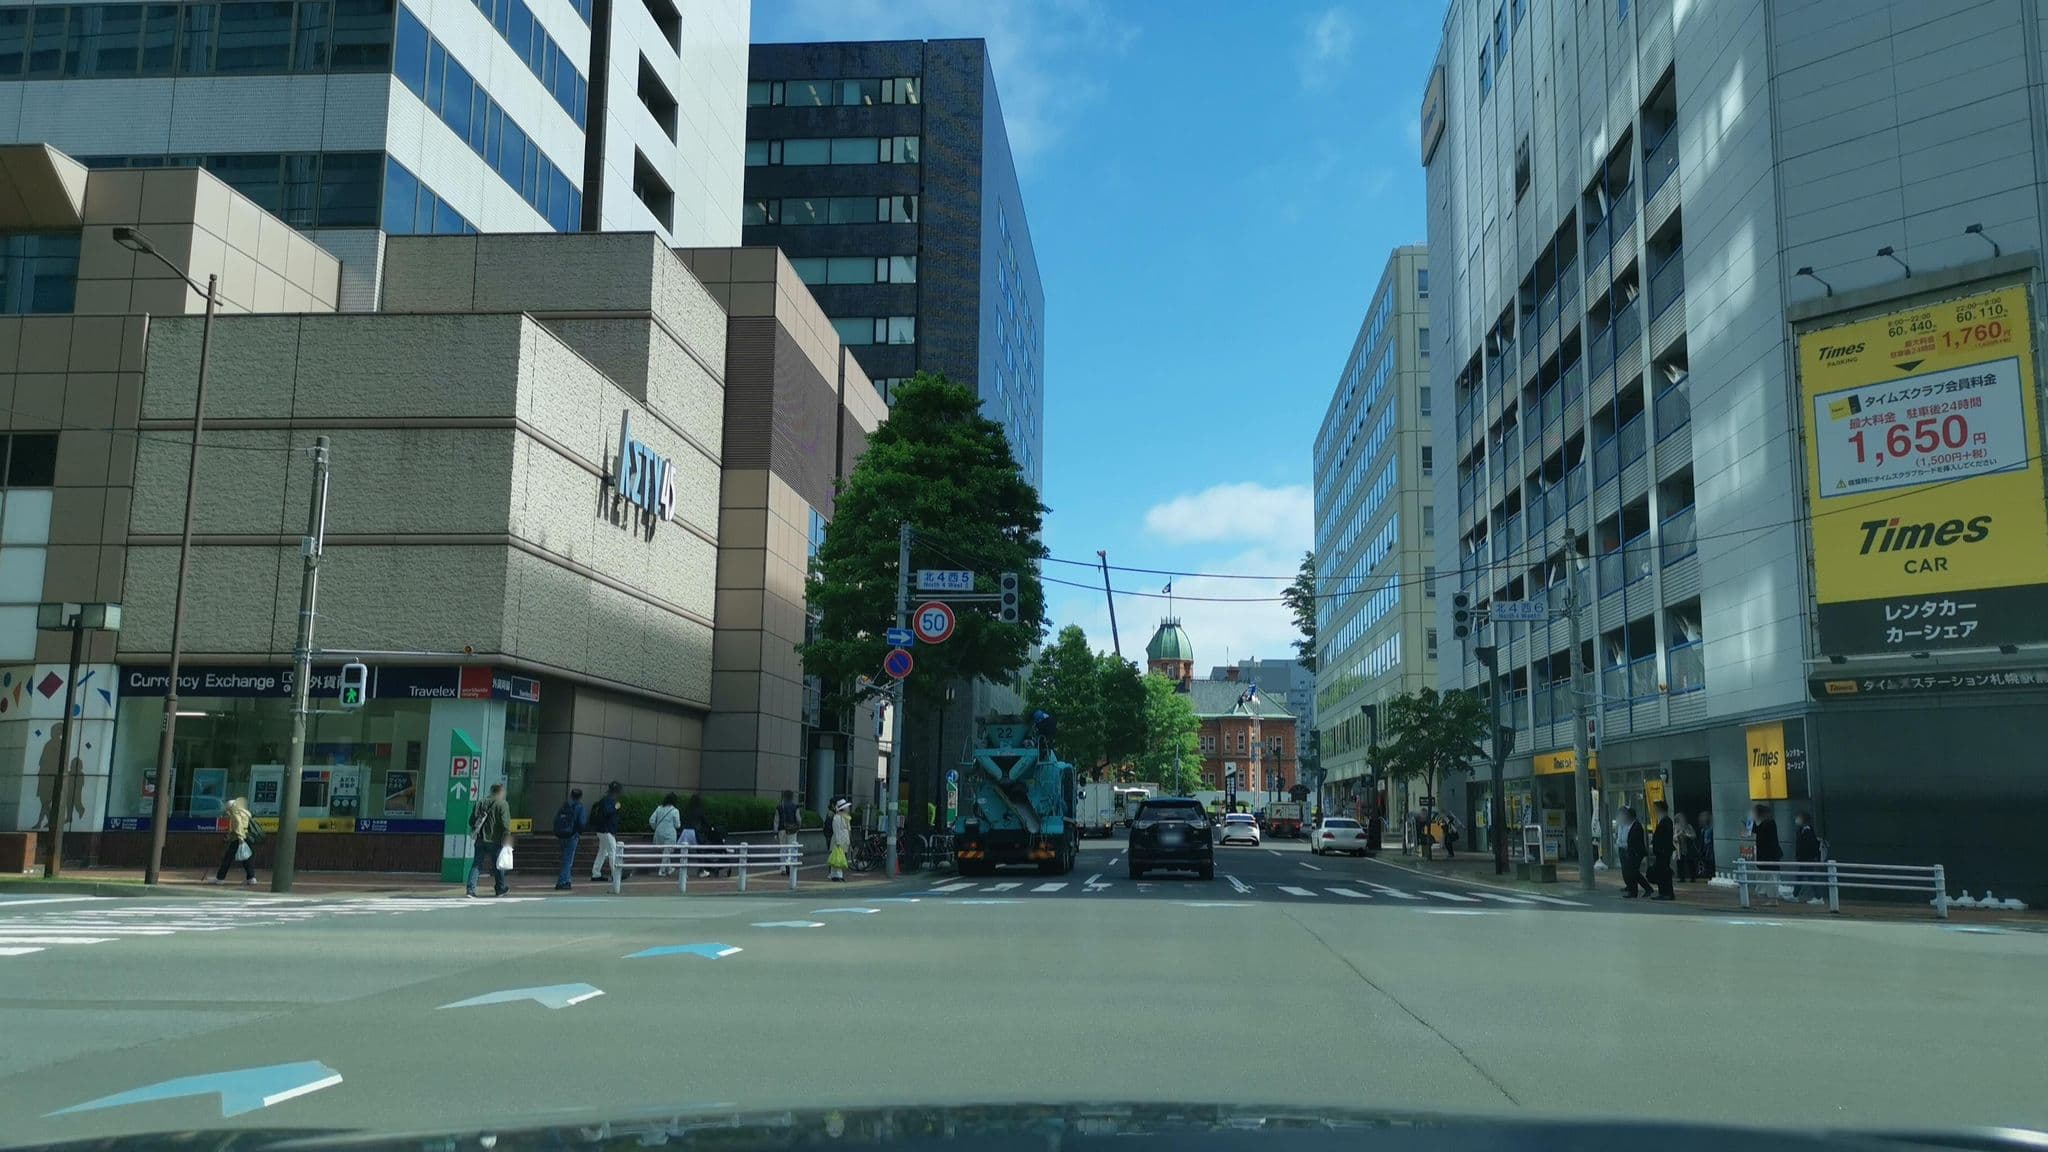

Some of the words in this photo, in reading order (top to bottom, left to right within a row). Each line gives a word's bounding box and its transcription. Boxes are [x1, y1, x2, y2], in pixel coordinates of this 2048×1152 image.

[1818, 341, 1866, 361] Times
[1826, 356, 1858, 368] PARKING
[1864, 373, 1998, 408] タイムズクラブ会員料金
[1859, 515, 1993, 555] Times
[1904, 557, 1948, 574] CAR
[1885, 600, 1977, 621] レンタカー
[923, 613, 945, 631] 50
[1886, 621, 1978, 643] カーシェア
[130, 673, 199, 689] Currency
[205, 674, 275, 690] Exchange
[309, 675, 342, 689] 外貨
[409, 685, 456, 697] Travelex
[997, 727, 1013, 739] 22
[1753, 748, 1778, 767] Times
[453, 758, 467, 775] P
